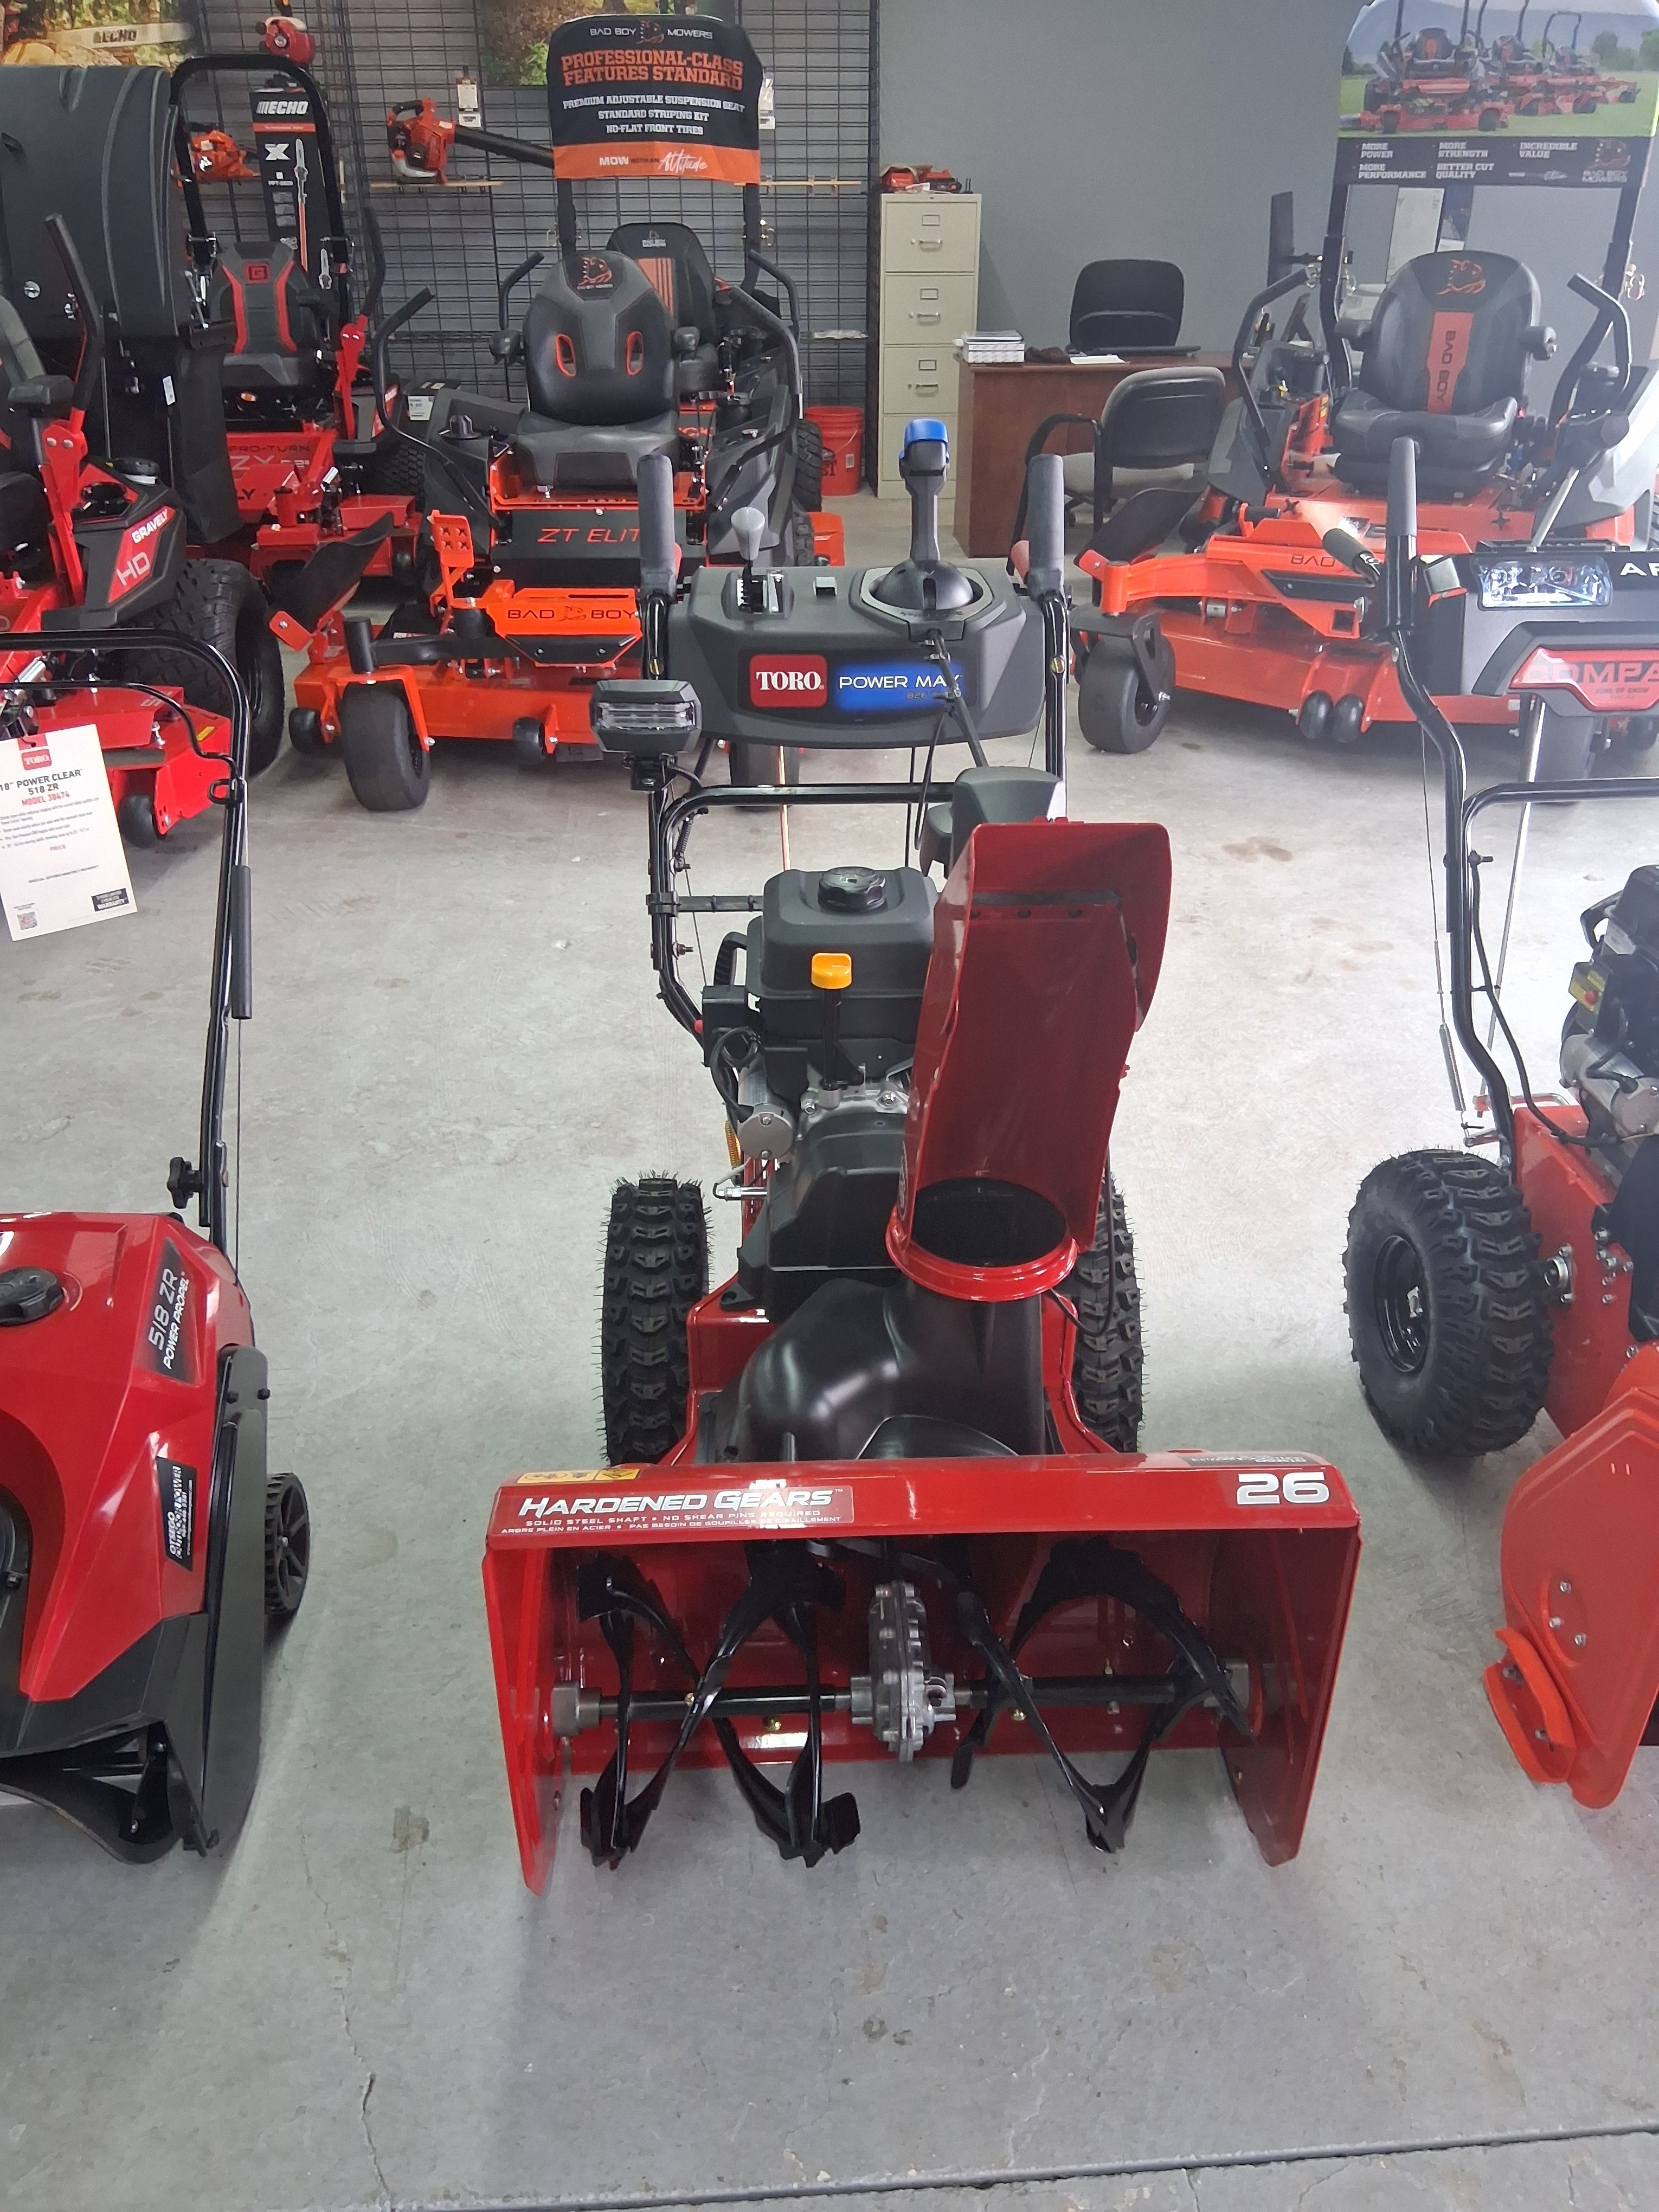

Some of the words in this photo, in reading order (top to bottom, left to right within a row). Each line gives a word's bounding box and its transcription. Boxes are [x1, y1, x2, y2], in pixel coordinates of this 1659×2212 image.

[590, 28, 612, 36] BAD
[614, 27, 637, 36] BOY
[667, 28, 713, 39] MOWERS
[561, 49, 744, 76] PROFESSIONAL-CLASS
[563, 64, 650, 87] FEATURES
[652, 66, 744, 92] STANDARD
[267, 101, 309, 114] ECHO
[562, 95, 605, 110] PREMIUM
[606, 94, 664, 105] ADJUSTABLE
[665, 95, 722, 109] SUSPENSION
[722, 101, 745, 113] SEAT
[598, 110, 647, 120] STANDARD
[648, 110, 692, 120] STRIPING
[693, 111, 710, 122] KIT
[606, 124, 644, 134] NO-FLAT
[644, 124, 674, 133] FRONT
[676, 125, 704, 136] TIRES
[1361, 143, 1388, 151] MORE
[1439, 142, 1467, 150] MORE
[1361, 150, 1393, 158] POWER
[1519, 150, 1551, 159] VALUE
[599, 156, 629, 166] MOW
[659, 150, 709, 174] Attitude
[1358, 171, 1427, 179] PERFORMANCE
[1436, 171, 1477, 179] QUALITY
[229, 445, 310, 453] PRO-TURN
[131, 508, 169, 544] GRAVELY
[537, 528, 580, 542] ZT
[587, 528, 640, 542] ELIT
[1291, 555, 1335, 567] BAD
[117, 551, 151, 586] HD
[507, 609, 555, 619] BAD
[591, 609, 636, 619] BOY
[756, 671, 821, 691] TORO
[839, 675, 909, 689] POWER
[915, 674, 960, 688] MA
[24, 754, 50, 766] TORO
[16, 775, 50, 788] POWER
[52, 769, 82, 781] CLEAR
[28, 786, 45, 795] 518
[47, 783, 59, 791] ZR
[21, 796, 46, 806] MODEL
[148, 1304, 170, 1351] 518
[159, 1268, 178, 1304] ZR
[163, 1322, 180, 1370] POWER
[173, 1277, 189, 1324] PROPEL
[1237, 1471, 1330, 1505] 26
[518, 1494, 708, 1519] HARDENED
